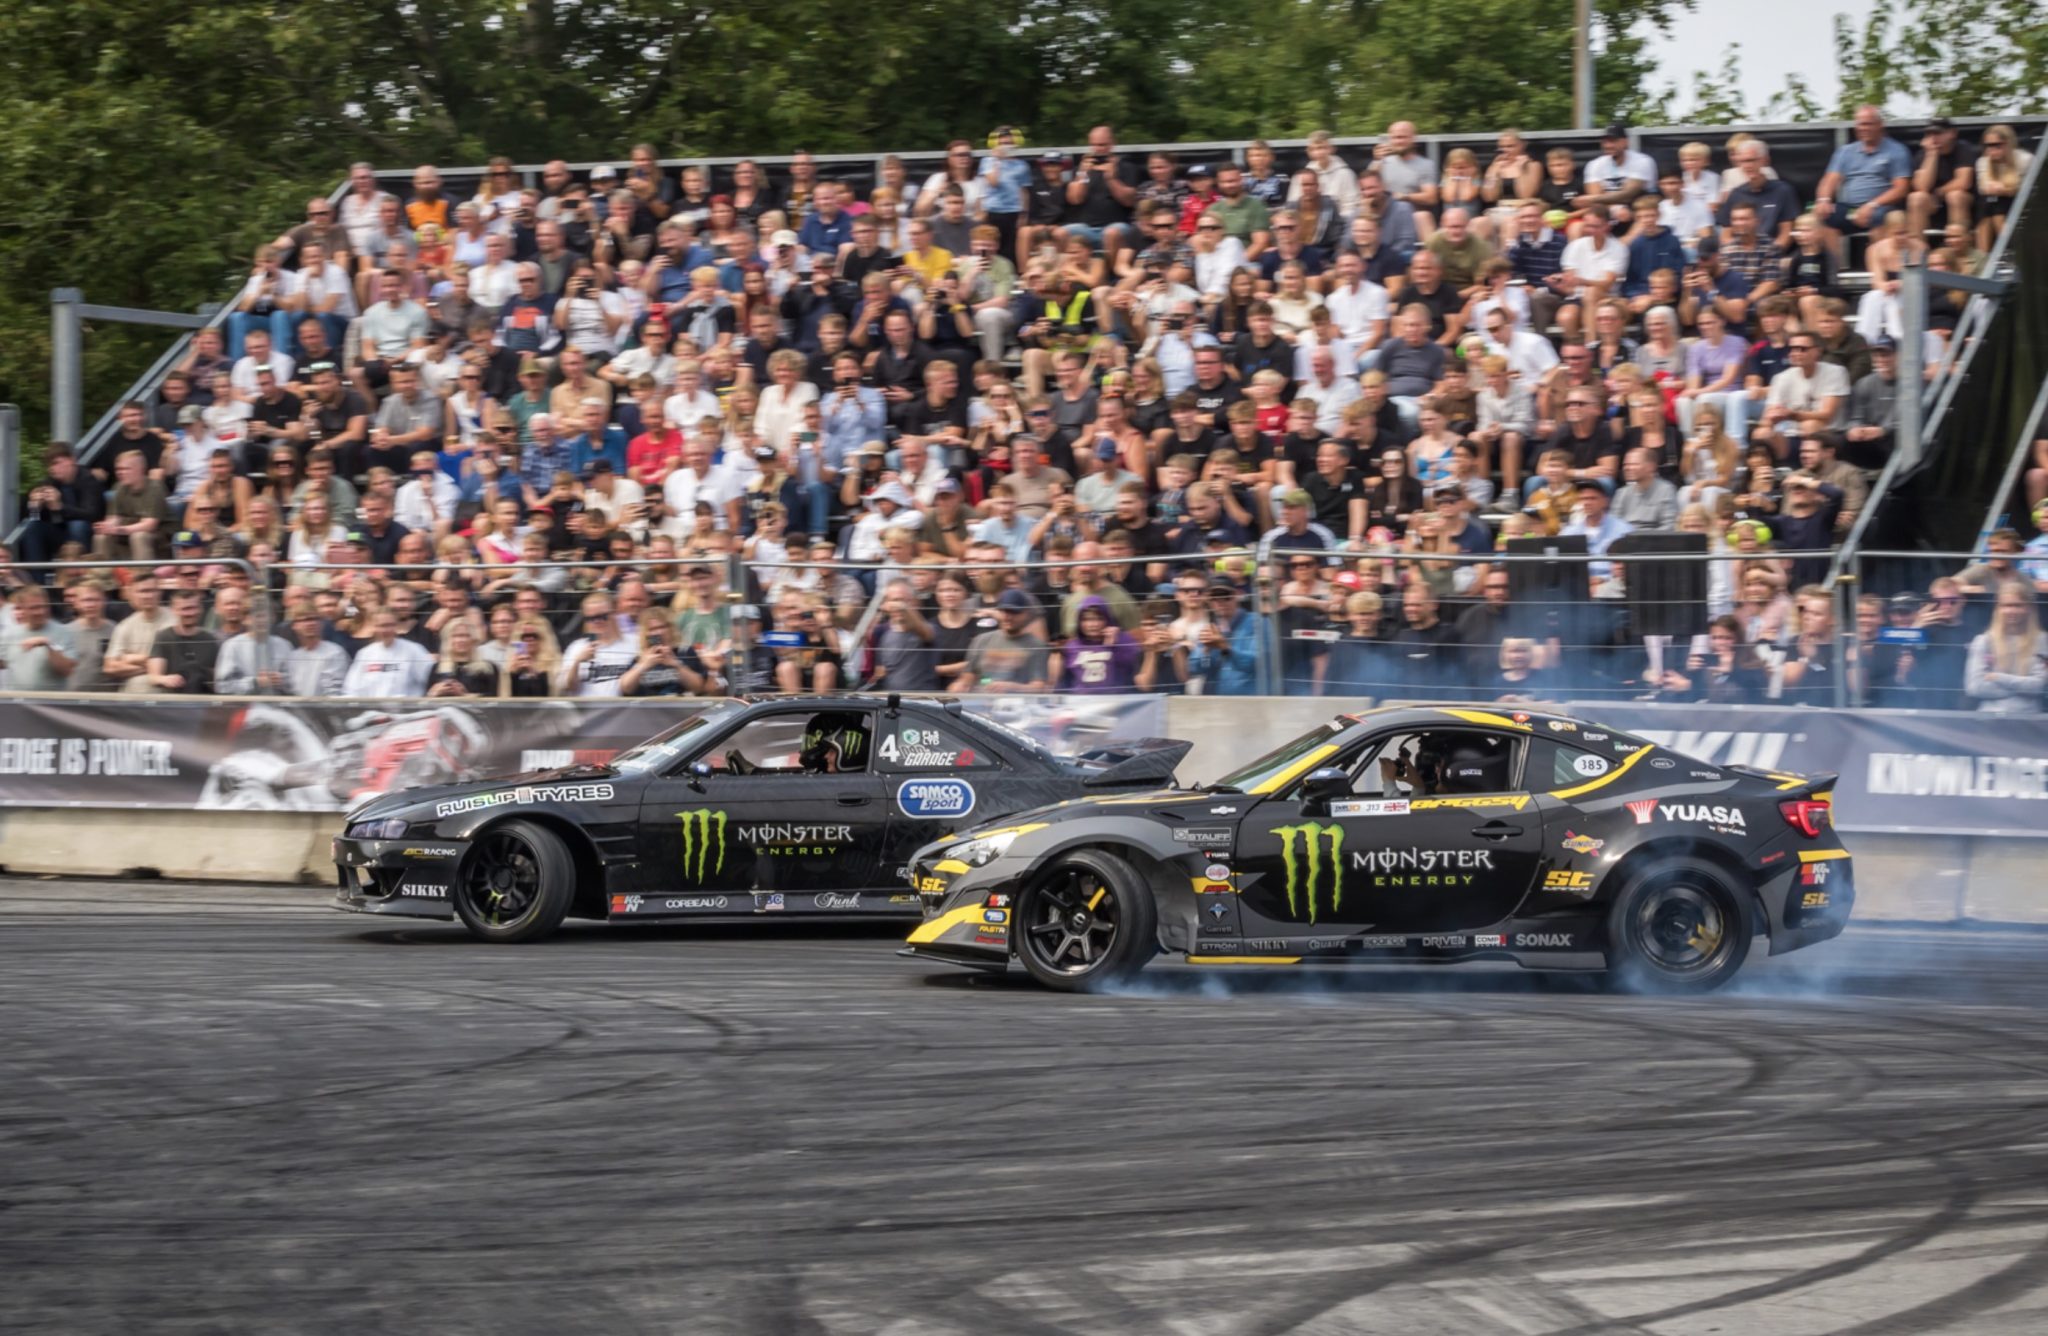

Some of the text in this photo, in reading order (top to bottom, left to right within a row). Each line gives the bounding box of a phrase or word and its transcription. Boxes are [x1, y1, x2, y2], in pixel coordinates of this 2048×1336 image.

[878, 733, 900, 763] 4
[59, 737, 87, 775] IS
[904, 752, 957, 766] GARAGE
[1582, 759, 1603, 770] 385
[909, 785, 962, 799] SAMCO
[437, 784, 614, 817] RUISLIP TYRES
[924, 798, 959, 811] sport
[1659, 804, 1746, 827] YUASA
[738, 823, 854, 845] MONSTER
[1188, 833, 1231, 841] STAUFF
[424, 848, 457, 857] RACING
[756, 847, 837, 855] ENERGY
[1353, 847, 1494, 873] MONSTER
[1375, 875, 1473, 886] ENERGY
[401, 884, 449, 897] SIKKY
[665, 898, 715, 909] CORBEAU
[1251, 939, 1290, 950] SIKKY
[1422, 935, 1466, 949] DRIVEN
[1515, 933, 1572, 946] SONAX
